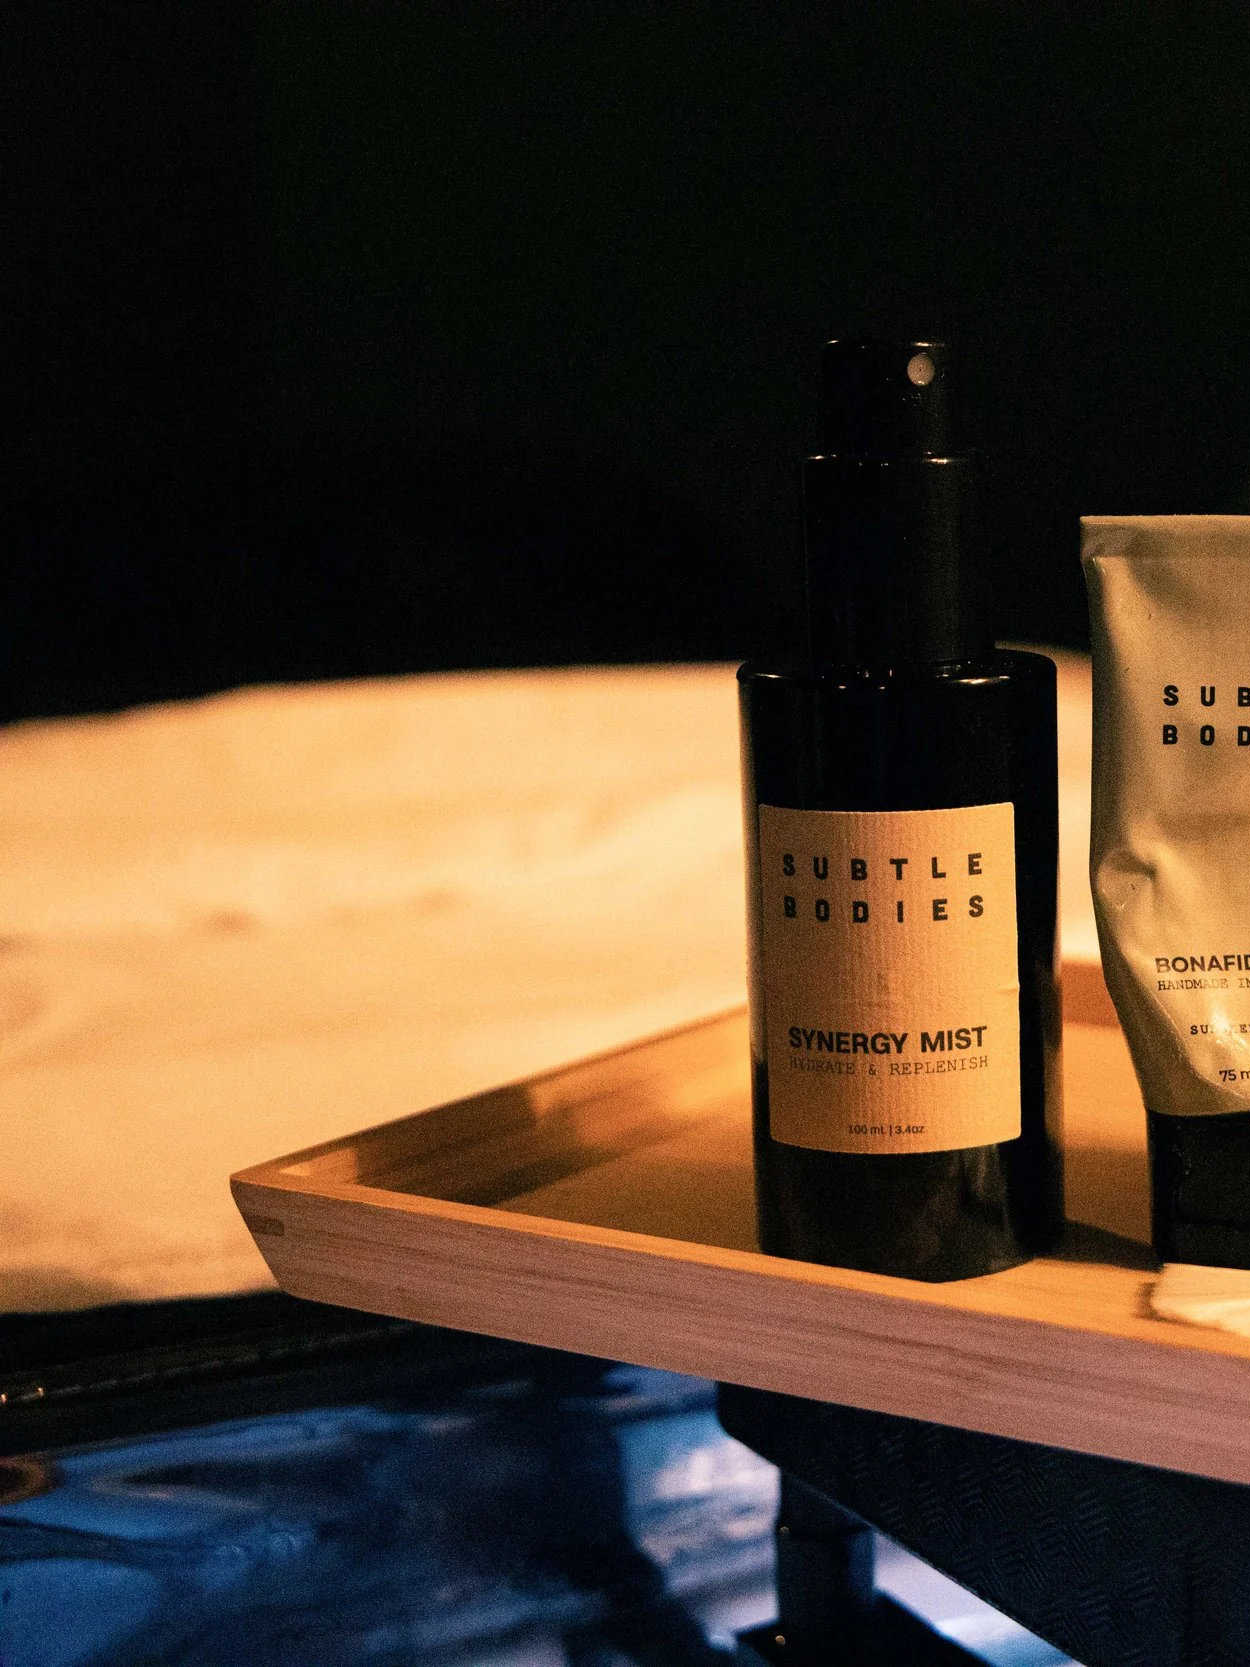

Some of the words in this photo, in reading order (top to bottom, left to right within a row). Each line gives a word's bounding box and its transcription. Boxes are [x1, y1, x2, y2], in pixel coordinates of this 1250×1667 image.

[783, 852, 983, 880] SUBTLE
[783, 895, 984, 923] BODIES
[1157, 978, 1229, 991] HANDMADE
[788, 1026, 909, 1054] SYNERGY
[920, 1026, 988, 1053] MIST
[789, 1055, 856, 1076] HYDRATE
[868, 1064, 877, 1075] &
[890, 1055, 989, 1076] REPLENISH
[1219, 1068, 1237, 1082] 75
[848, 1124, 868, 1135] 100
